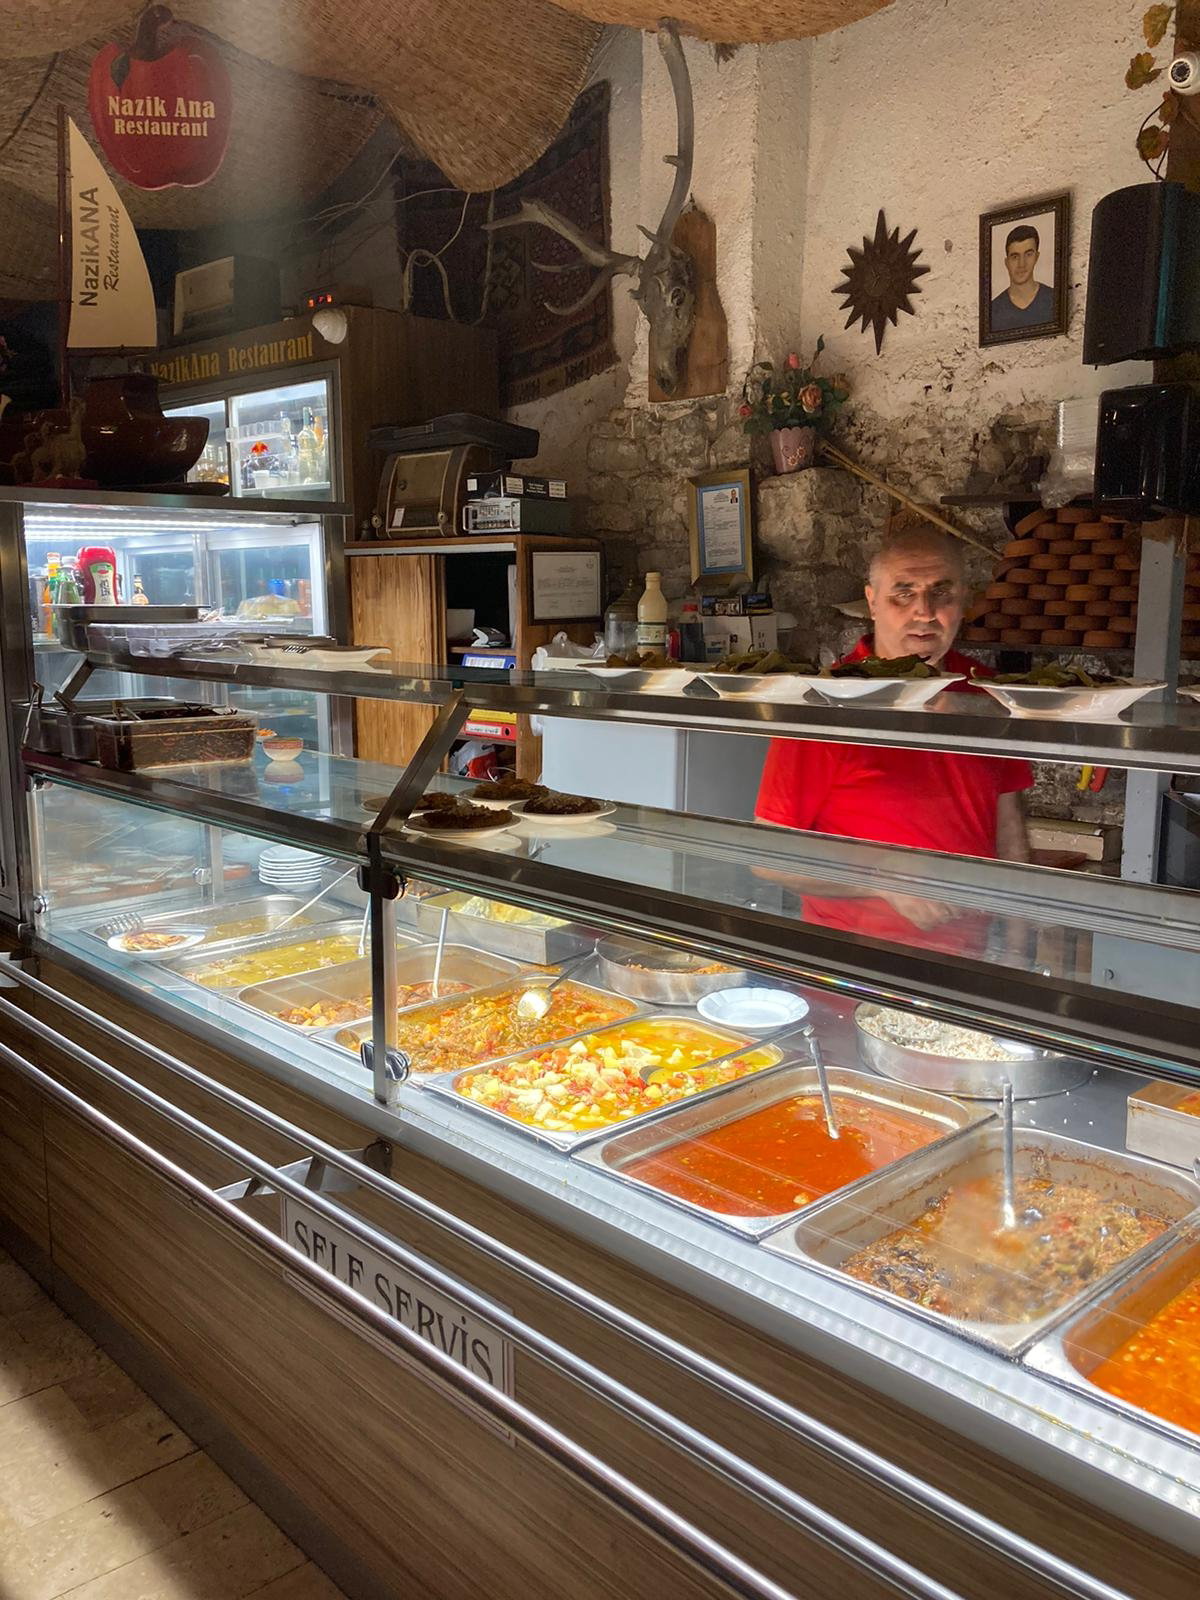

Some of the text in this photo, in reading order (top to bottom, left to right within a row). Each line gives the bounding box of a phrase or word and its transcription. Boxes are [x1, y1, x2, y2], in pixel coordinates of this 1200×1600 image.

[108, 96, 215, 118] Nazik Ana
[114, 119, 208, 137] Restaurant
[79, 187, 100, 306] NazikANA
[103, 205, 120, 292] Restaurant
[228, 331, 313, 372] Restaurant
